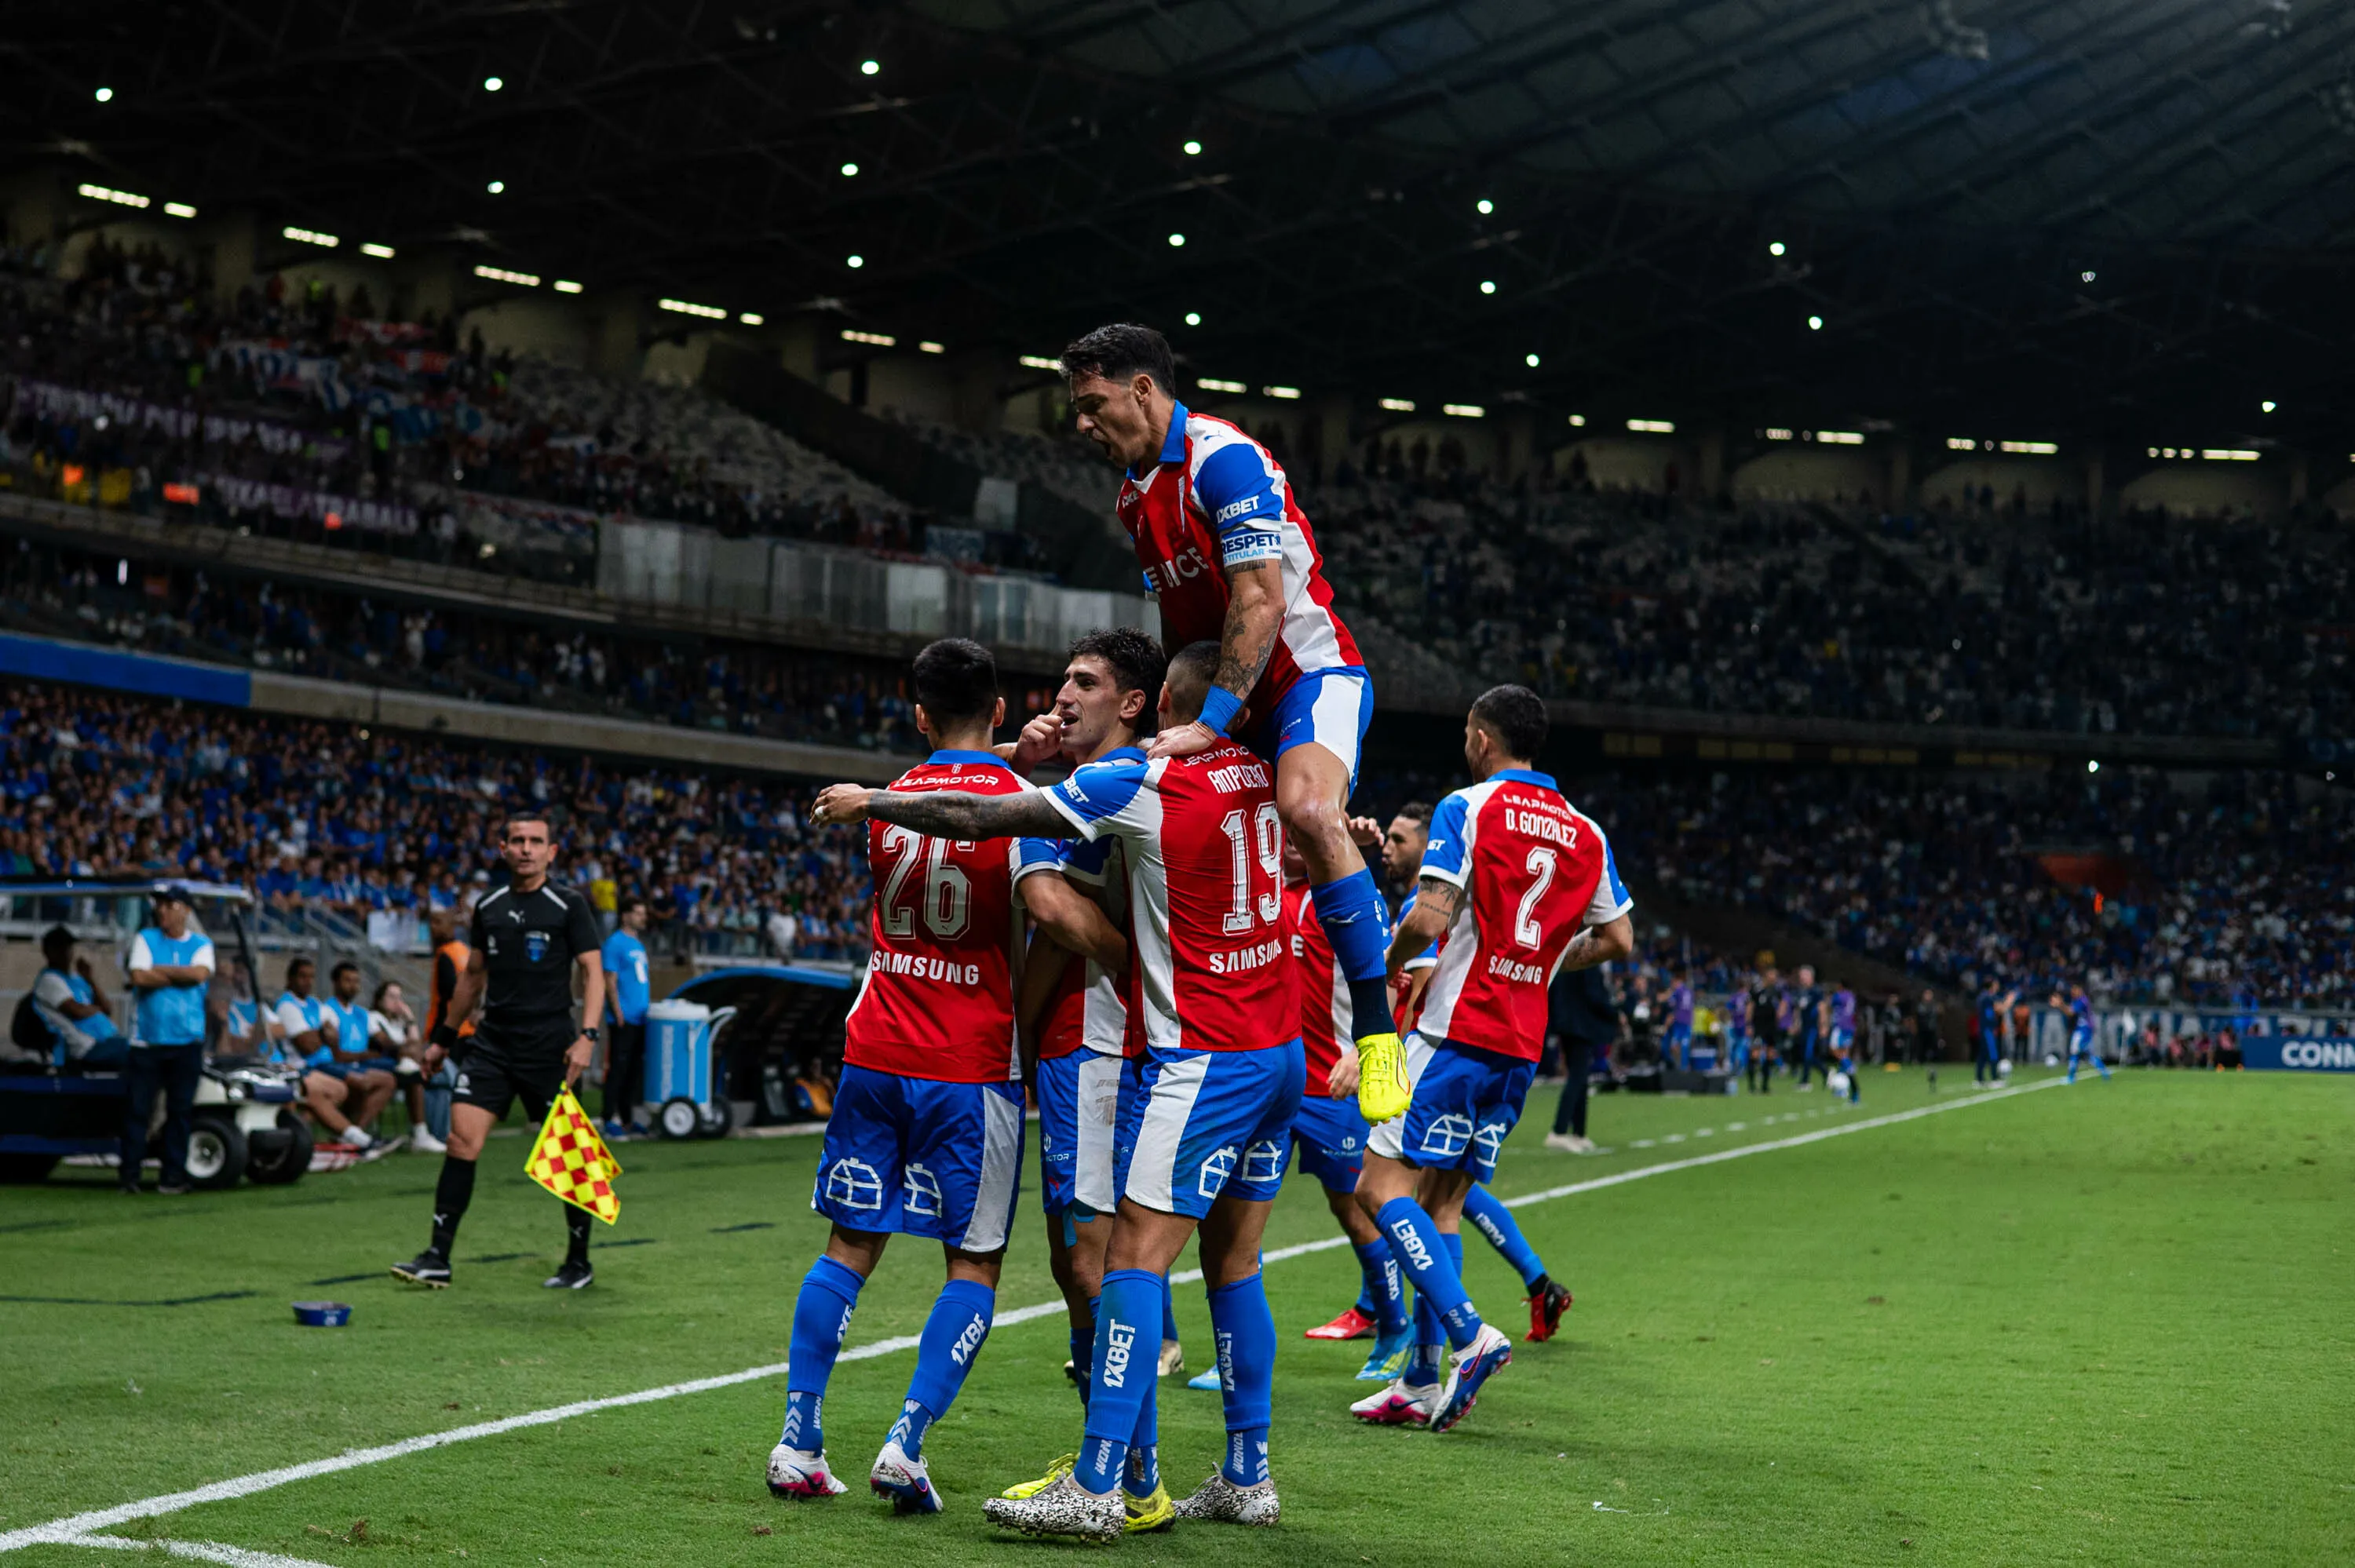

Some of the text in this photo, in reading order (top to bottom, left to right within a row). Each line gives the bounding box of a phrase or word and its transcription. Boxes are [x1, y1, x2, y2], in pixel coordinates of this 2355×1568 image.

[1216, 495, 1259, 523] 1XBET
[893, 774, 999, 788] LEAPMOTOR
[1505, 808, 1519, 832] D.
[882, 825, 975, 941] 26
[1221, 800, 1282, 937] 19
[1515, 846, 1557, 951] 2
[872, 950, 980, 986] SAMSUNG
[1391, 1218, 1434, 1271] 1XBET
[1103, 1318, 1136, 1388] 1XBET
